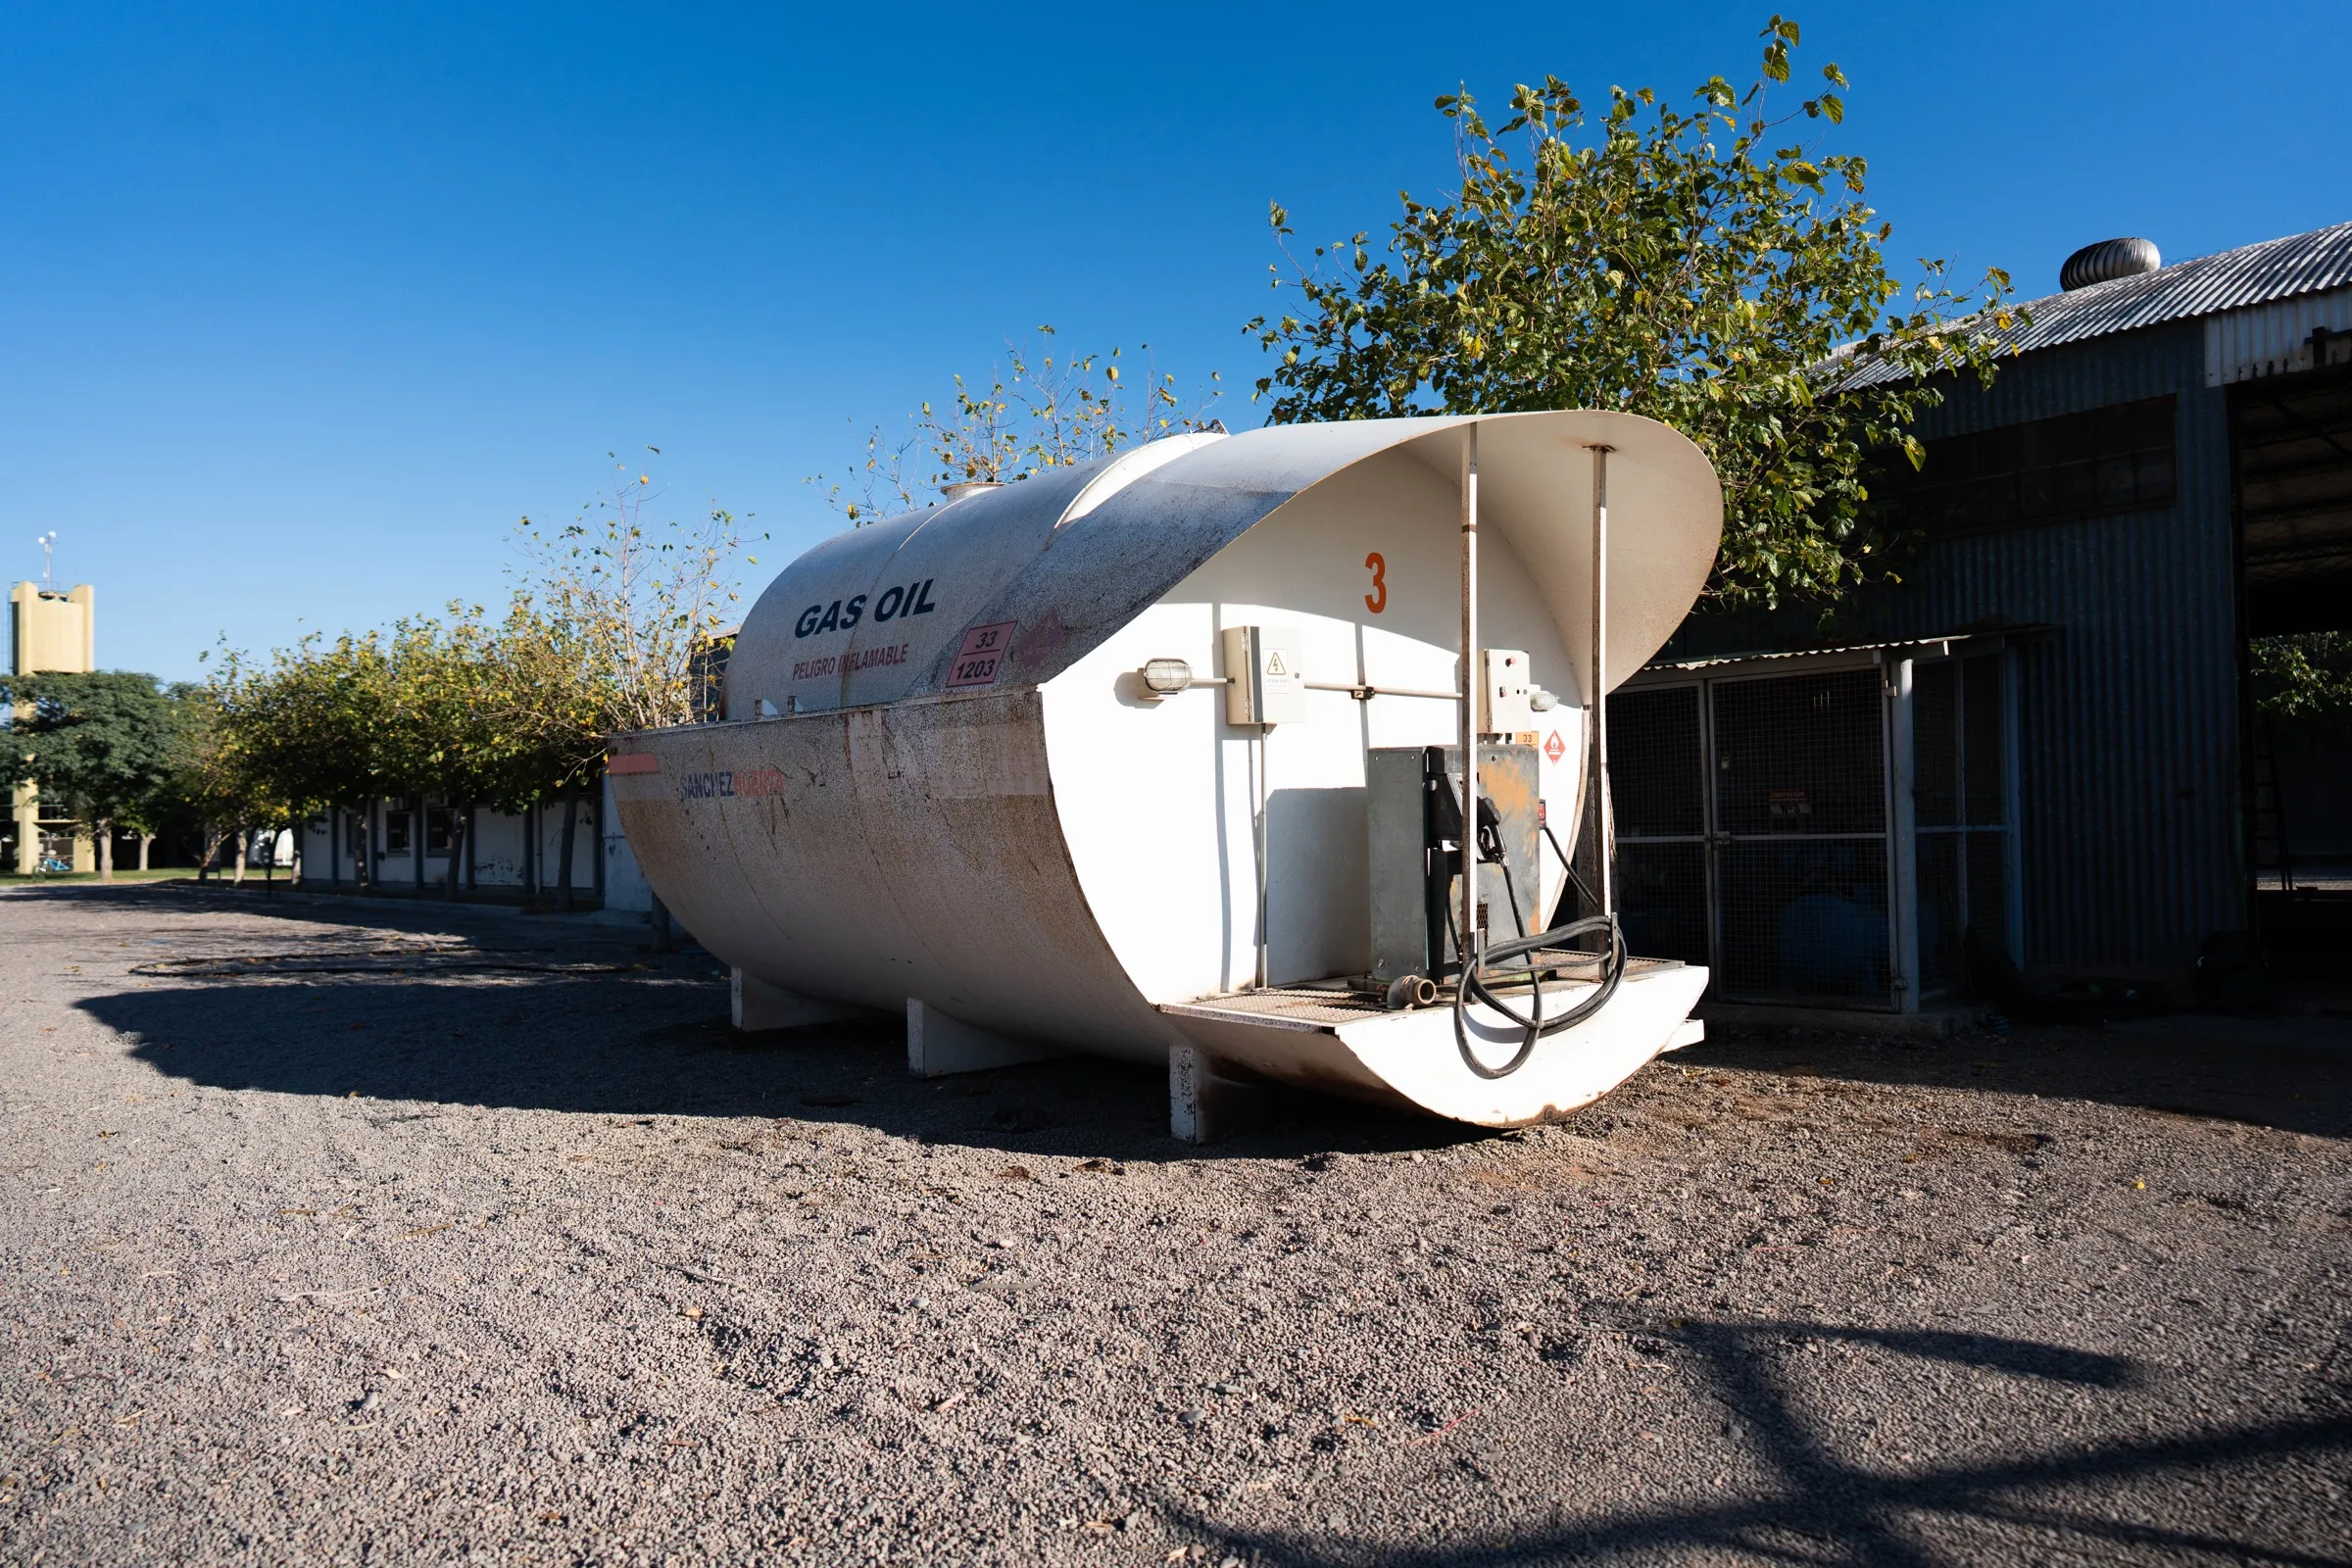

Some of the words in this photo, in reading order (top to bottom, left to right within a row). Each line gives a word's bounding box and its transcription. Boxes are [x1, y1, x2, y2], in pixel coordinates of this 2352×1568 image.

[1364, 552, 1387, 613] 3
[795, 594, 867, 639] GAS
[874, 578, 936, 622] OIL
[975, 630, 999, 649] 33
[792, 657, 836, 681] PELIGRO
[838, 643, 909, 673] INFLAMABLE
[956, 659, 996, 679] 1203
[1523, 734, 1533, 743] 33
